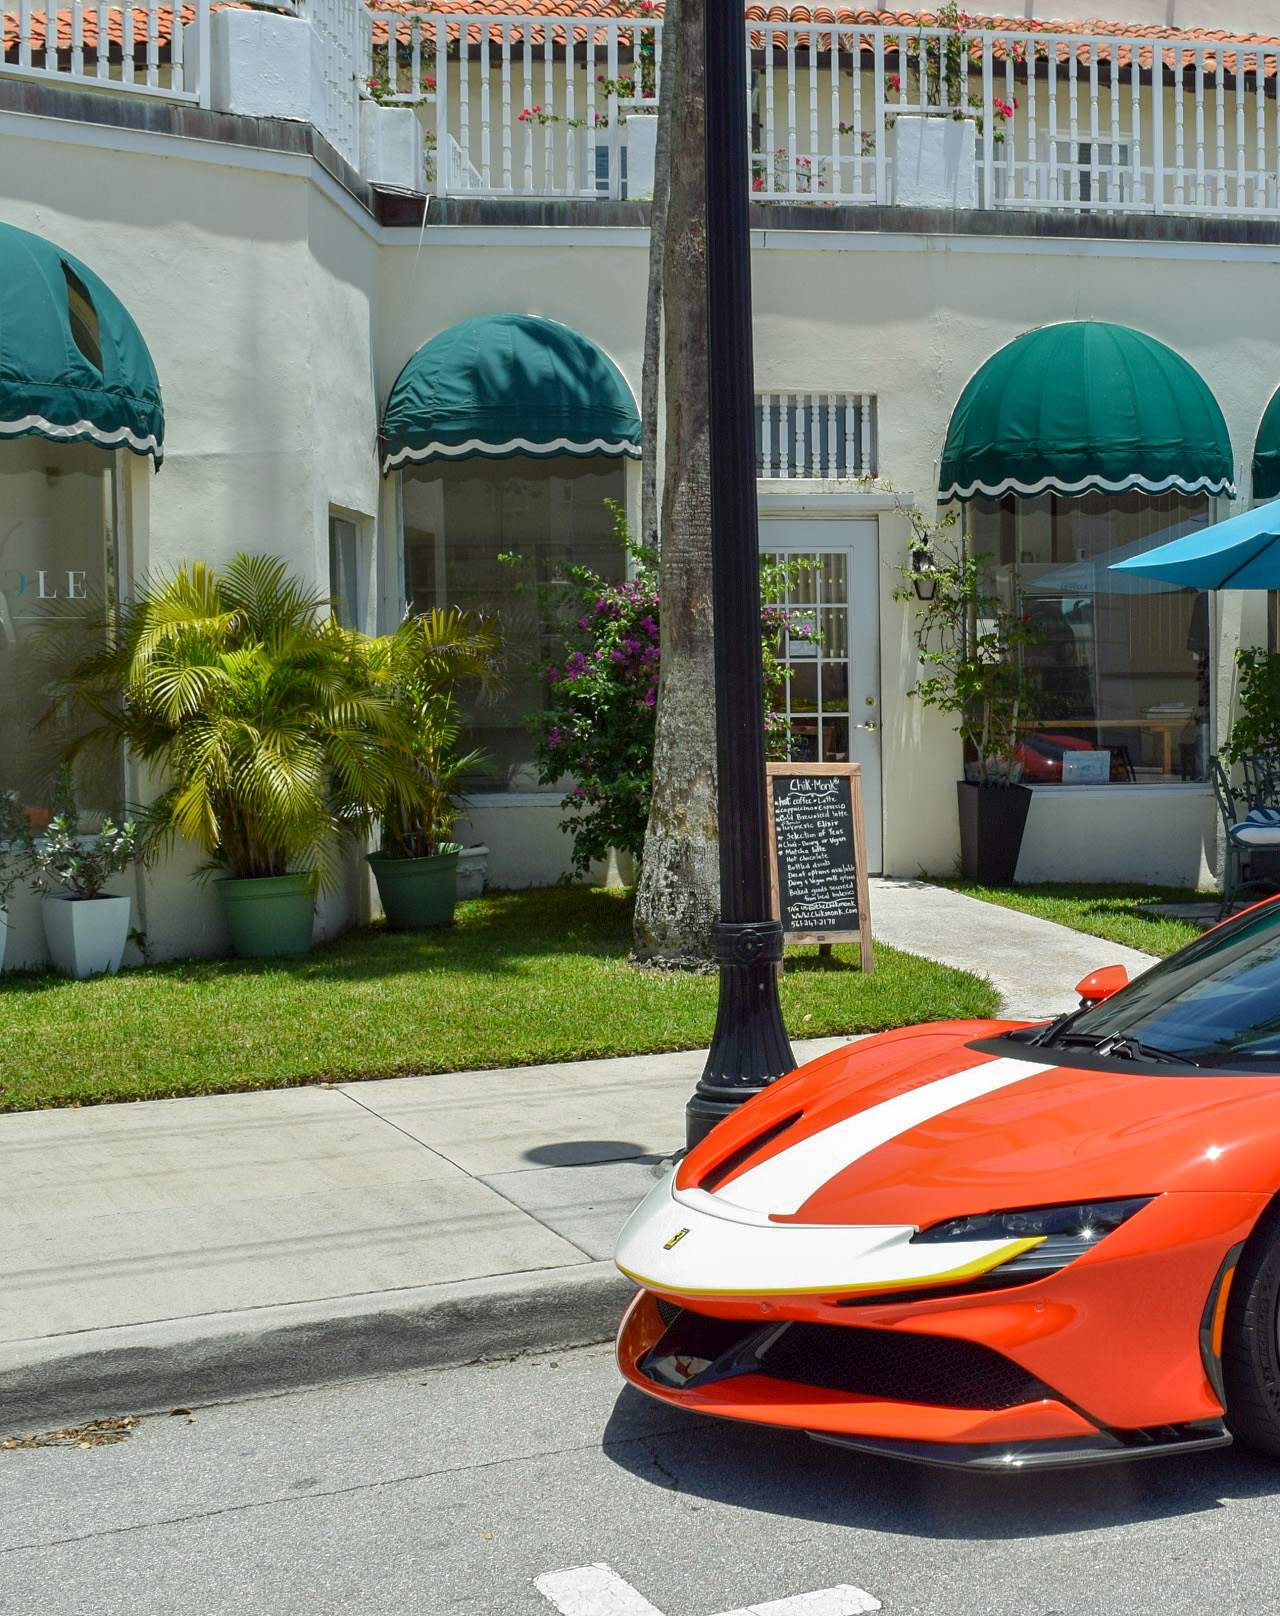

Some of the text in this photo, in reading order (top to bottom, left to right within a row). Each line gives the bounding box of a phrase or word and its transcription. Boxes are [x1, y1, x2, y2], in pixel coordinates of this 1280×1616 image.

[793, 797, 813, 805] coffee
[818, 796, 837, 804] Latte
[817, 820, 839, 828] Elixir
[787, 831, 817, 841] Selection
[819, 828, 826, 837] of
[786, 852, 829, 862] Hot chocolate
[787, 862, 811, 871] Bottled
[787, 870, 806, 879] Decaf
[789, 887, 809, 897] Baked
